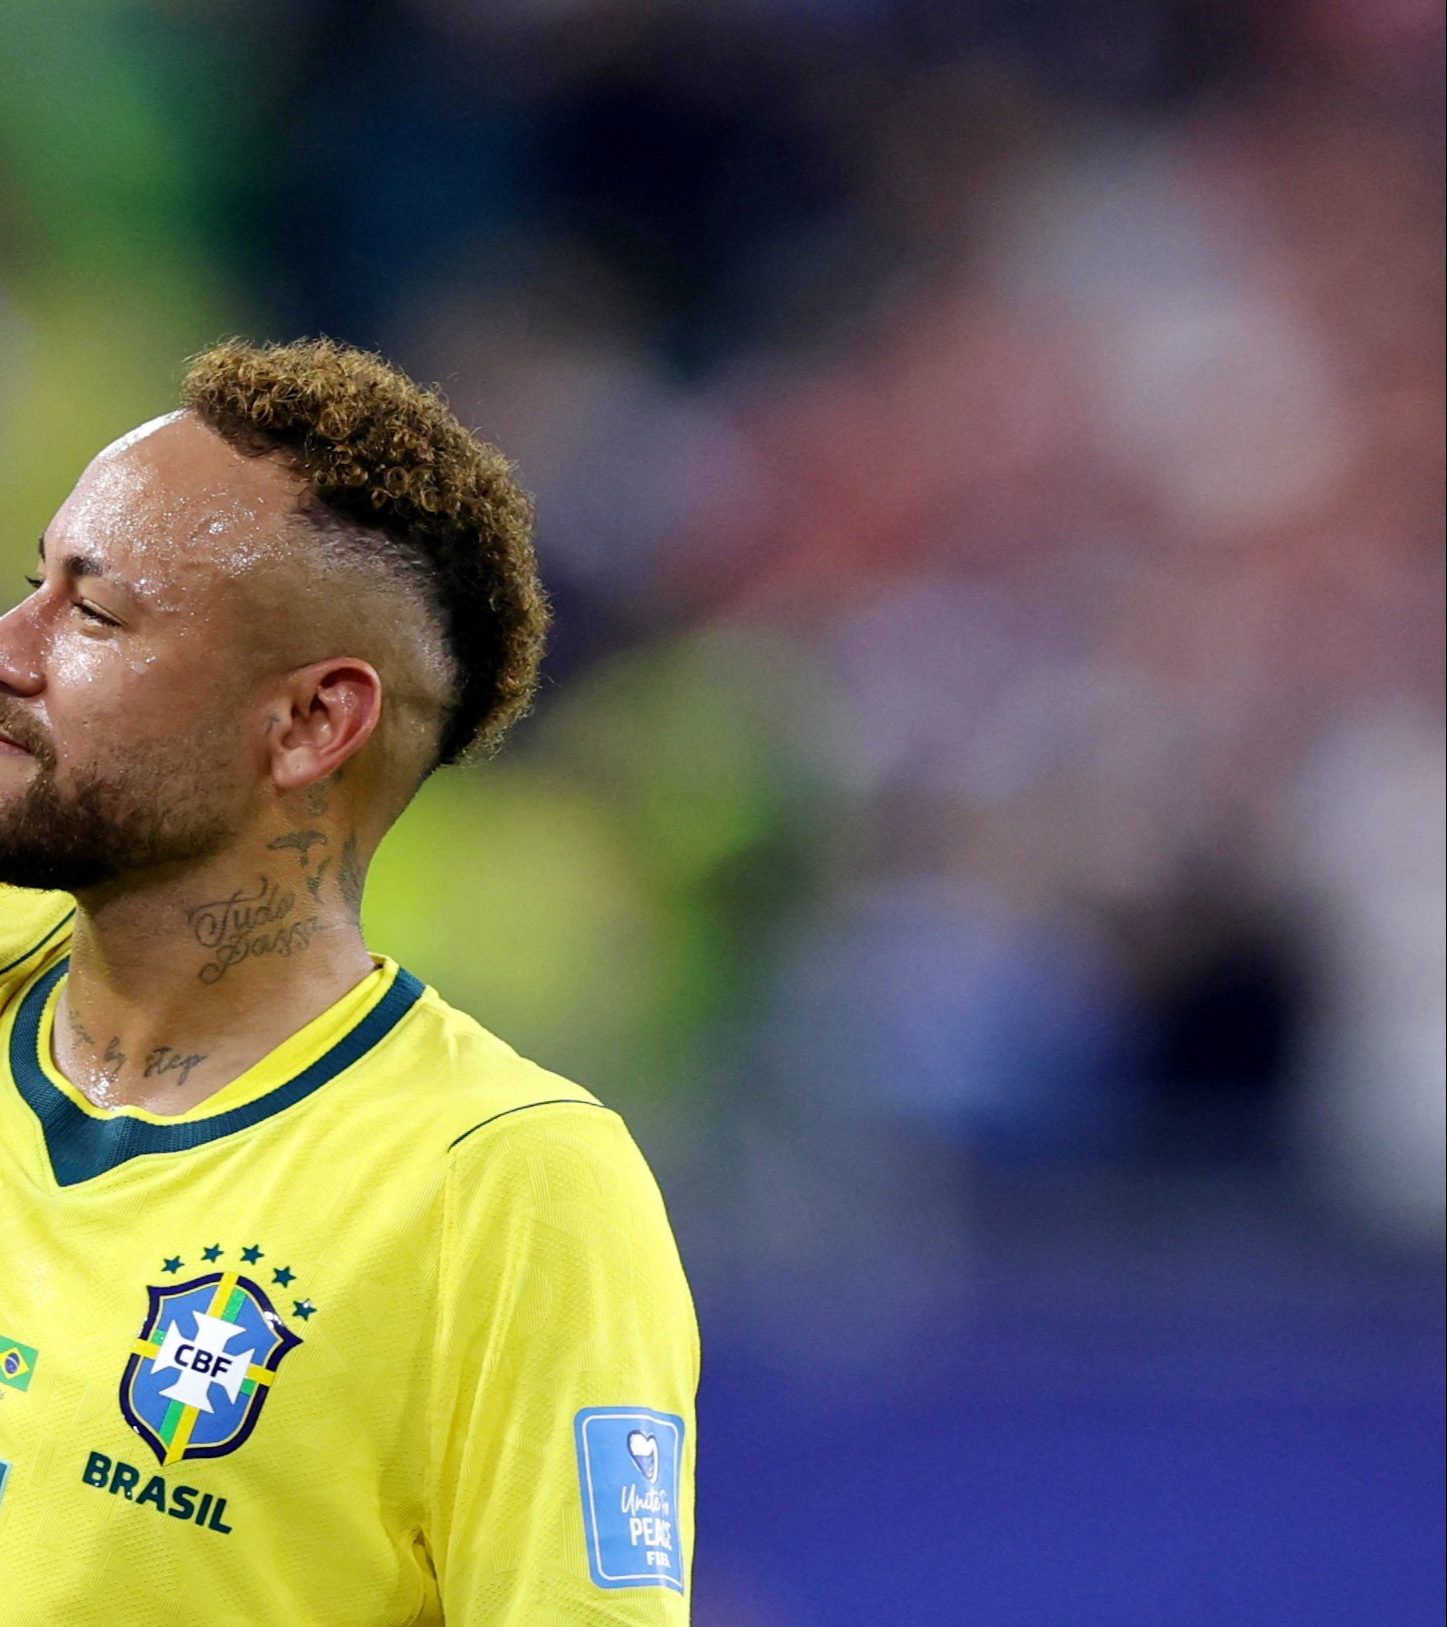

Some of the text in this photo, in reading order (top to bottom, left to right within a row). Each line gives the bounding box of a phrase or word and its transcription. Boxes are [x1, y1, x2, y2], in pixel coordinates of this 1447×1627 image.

[188, 876, 295, 948] Tudo
[174, 1344, 233, 1378] CBF
[82, 1451, 232, 1535] BRASIL
